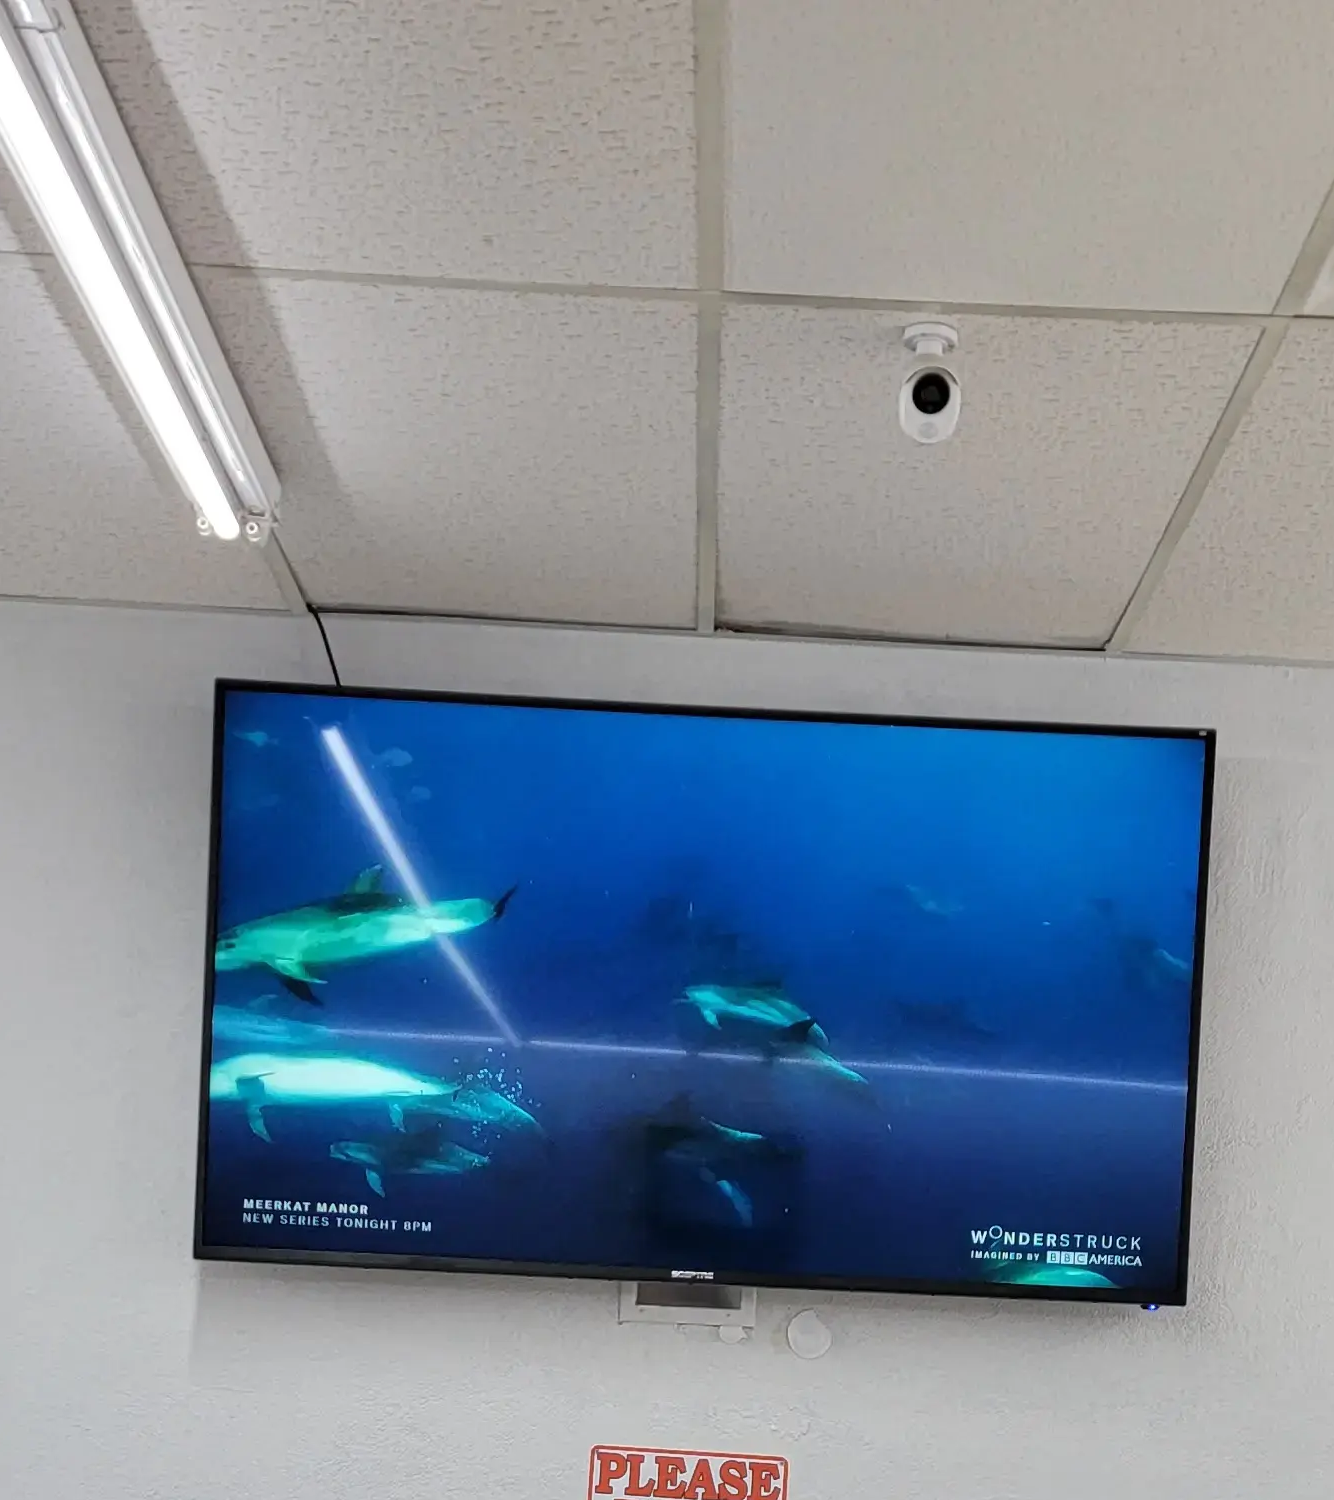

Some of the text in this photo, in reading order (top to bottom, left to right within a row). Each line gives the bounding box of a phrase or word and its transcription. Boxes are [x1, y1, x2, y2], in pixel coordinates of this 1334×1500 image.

[243, 1198, 368, 1215] MEERKAT MANOR
[242, 1212, 432, 1232] NEW SERIES TONIGHT 8PM
[971, 1225, 1141, 1250] WONDERSTRUCK
[970, 1250, 1022, 1260] IMAGINED
[1027, 1252, 1040, 1261] BY
